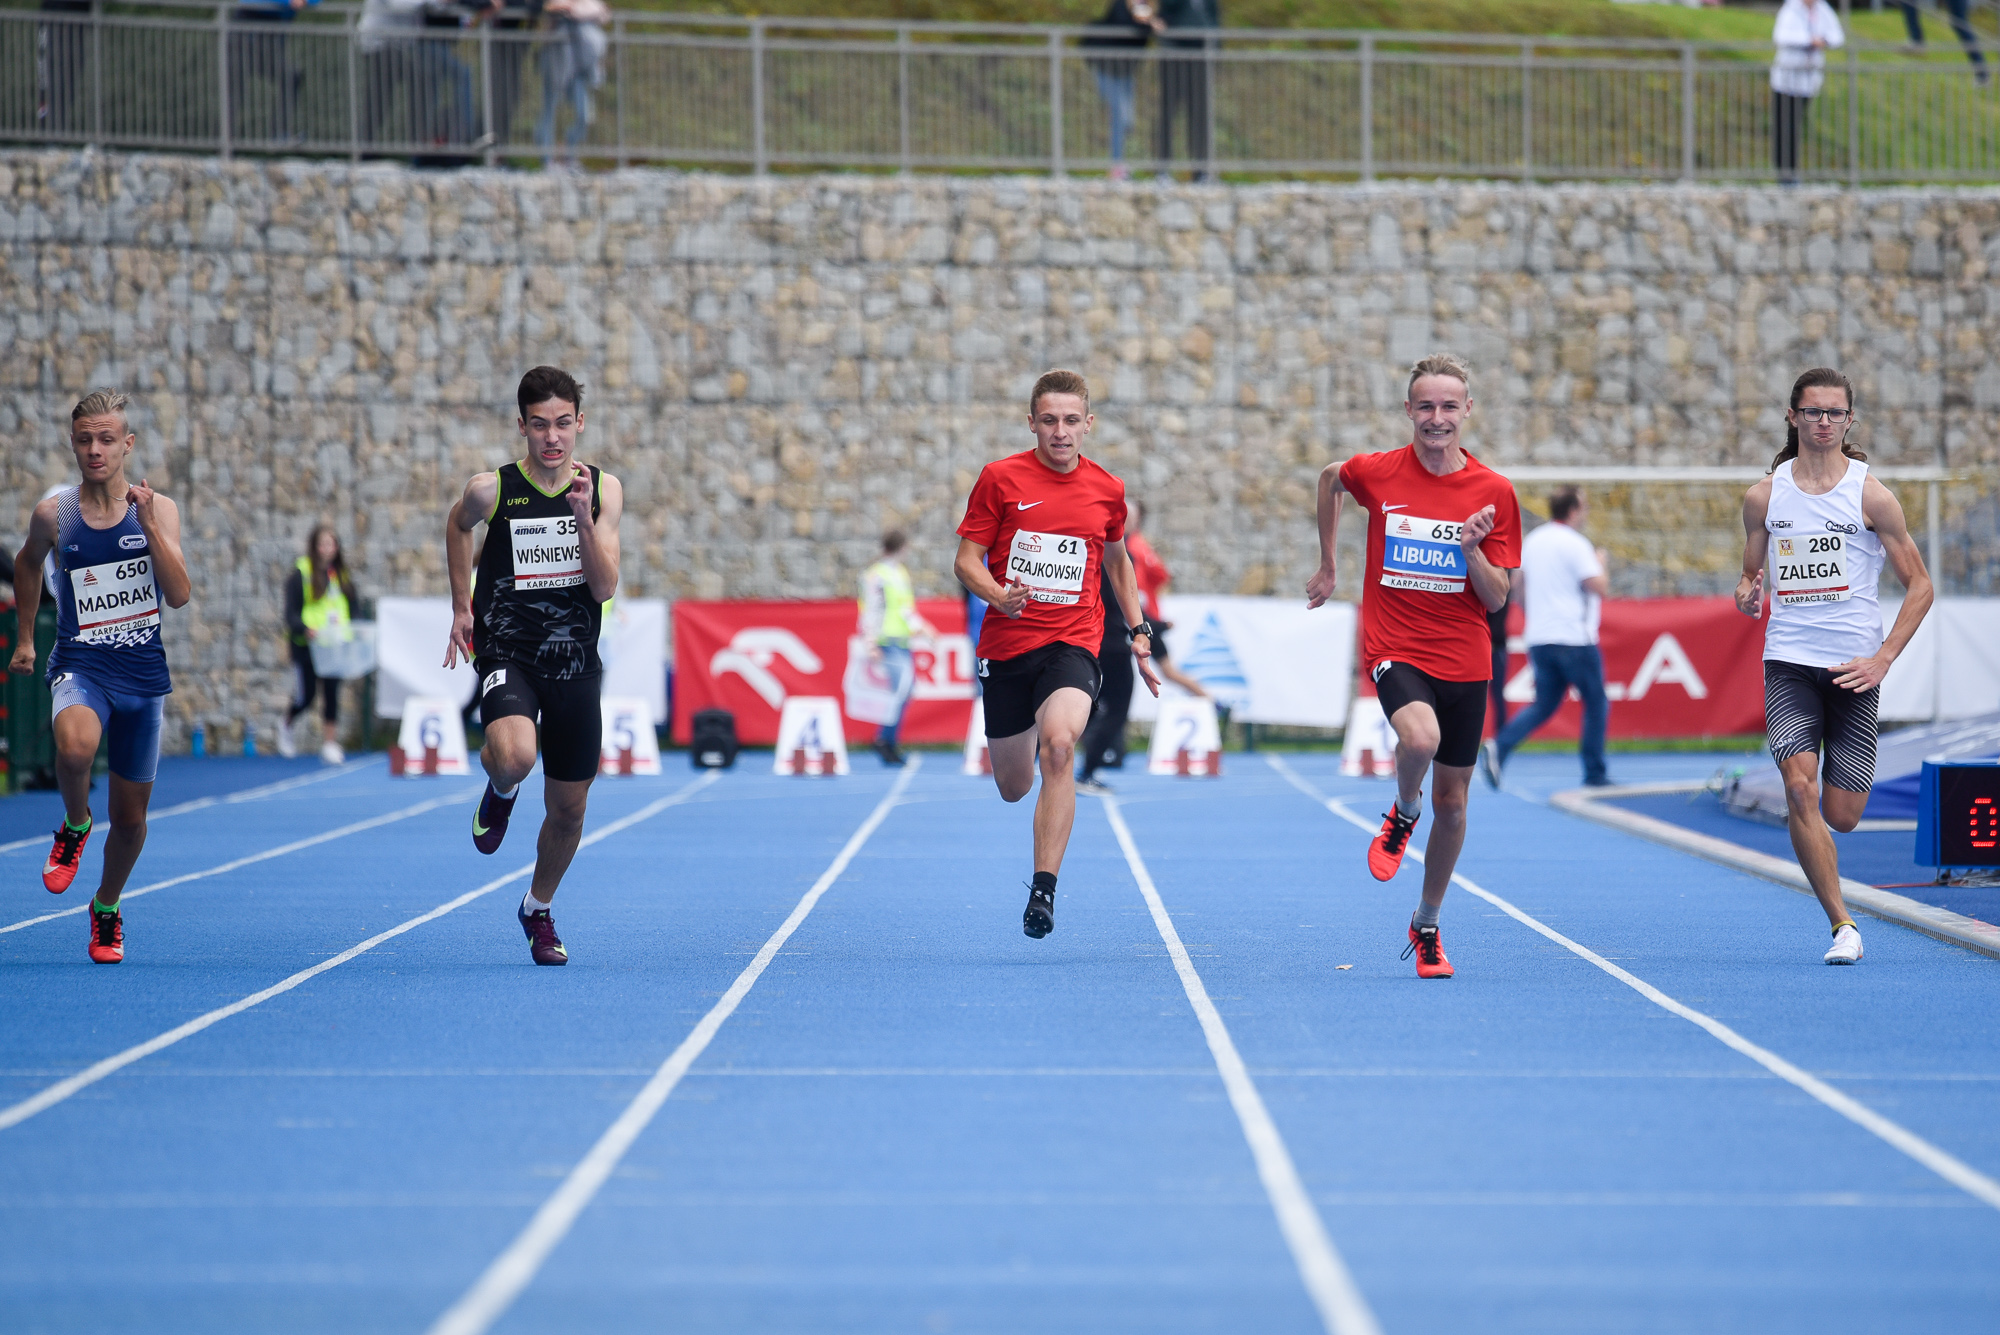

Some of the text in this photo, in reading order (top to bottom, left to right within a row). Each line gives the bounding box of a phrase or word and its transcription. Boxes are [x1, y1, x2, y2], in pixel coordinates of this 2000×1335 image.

[514, 527, 547, 536] 4MOVE
[1431, 524, 1462, 541] 655
[1018, 542, 1041, 552] ORLEN
[1057, 539, 1078, 555] 61
[1808, 536, 1841, 553] 280
[1392, 545, 1457, 568] LIBURA
[116, 560, 148, 580] 650
[1011, 556, 1082, 581] CZAJKOWSKI
[1779, 562, 1841, 581] ZALEGA
[527, 580, 566, 589] KARPACZ
[568, 575, 585, 585] 2021
[1390, 578, 1452, 591] KARPACZ 2021
[78, 584, 154, 614] MADRAK
[1785, 593, 1840, 604] KARPACZ 2021
[92, 622, 132, 637] KARPACZ
[132, 618, 151, 630] 2021
[486, 672, 500, 689] 4
[420, 714, 443, 751] 6
[613, 714, 634, 750] 5
[1970, 797, 1997, 847] 0
